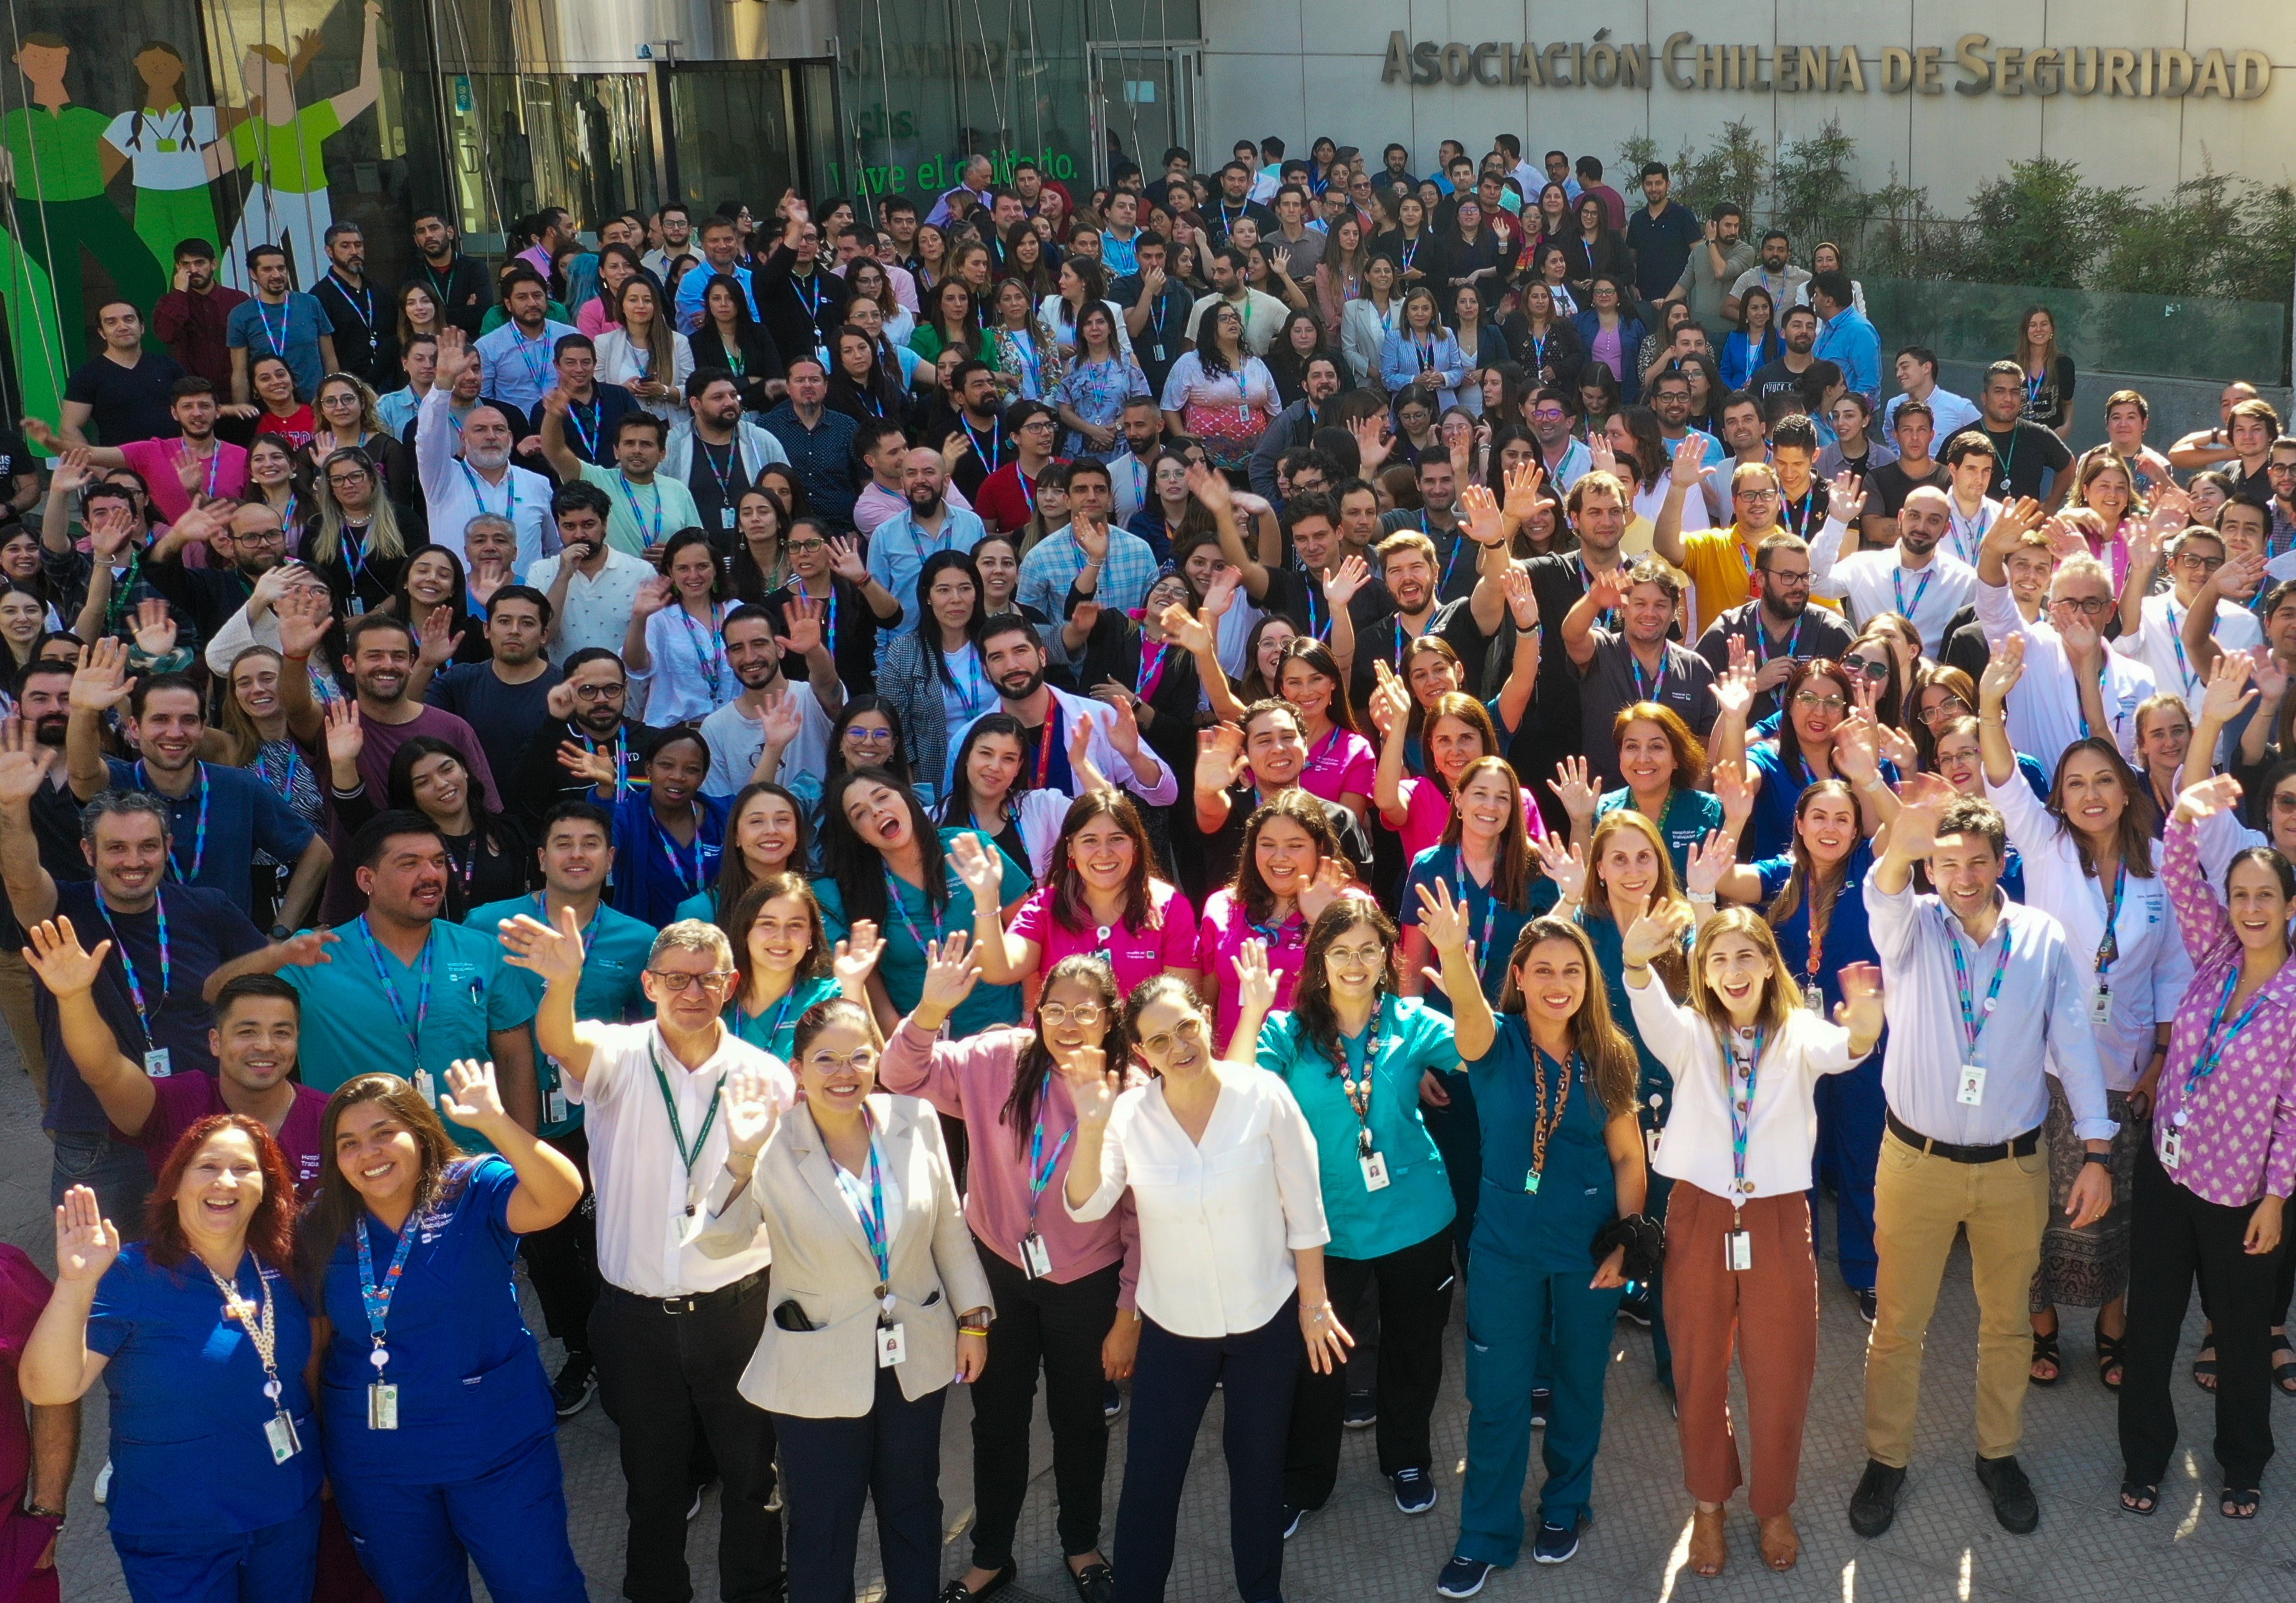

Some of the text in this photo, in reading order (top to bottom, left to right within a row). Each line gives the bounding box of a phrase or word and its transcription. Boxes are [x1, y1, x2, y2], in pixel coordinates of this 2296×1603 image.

[1381, 27, 2272, 99] ASOCIACIÓN CHILENA DE SEGURIDAD
[918, 154, 946, 190] el
